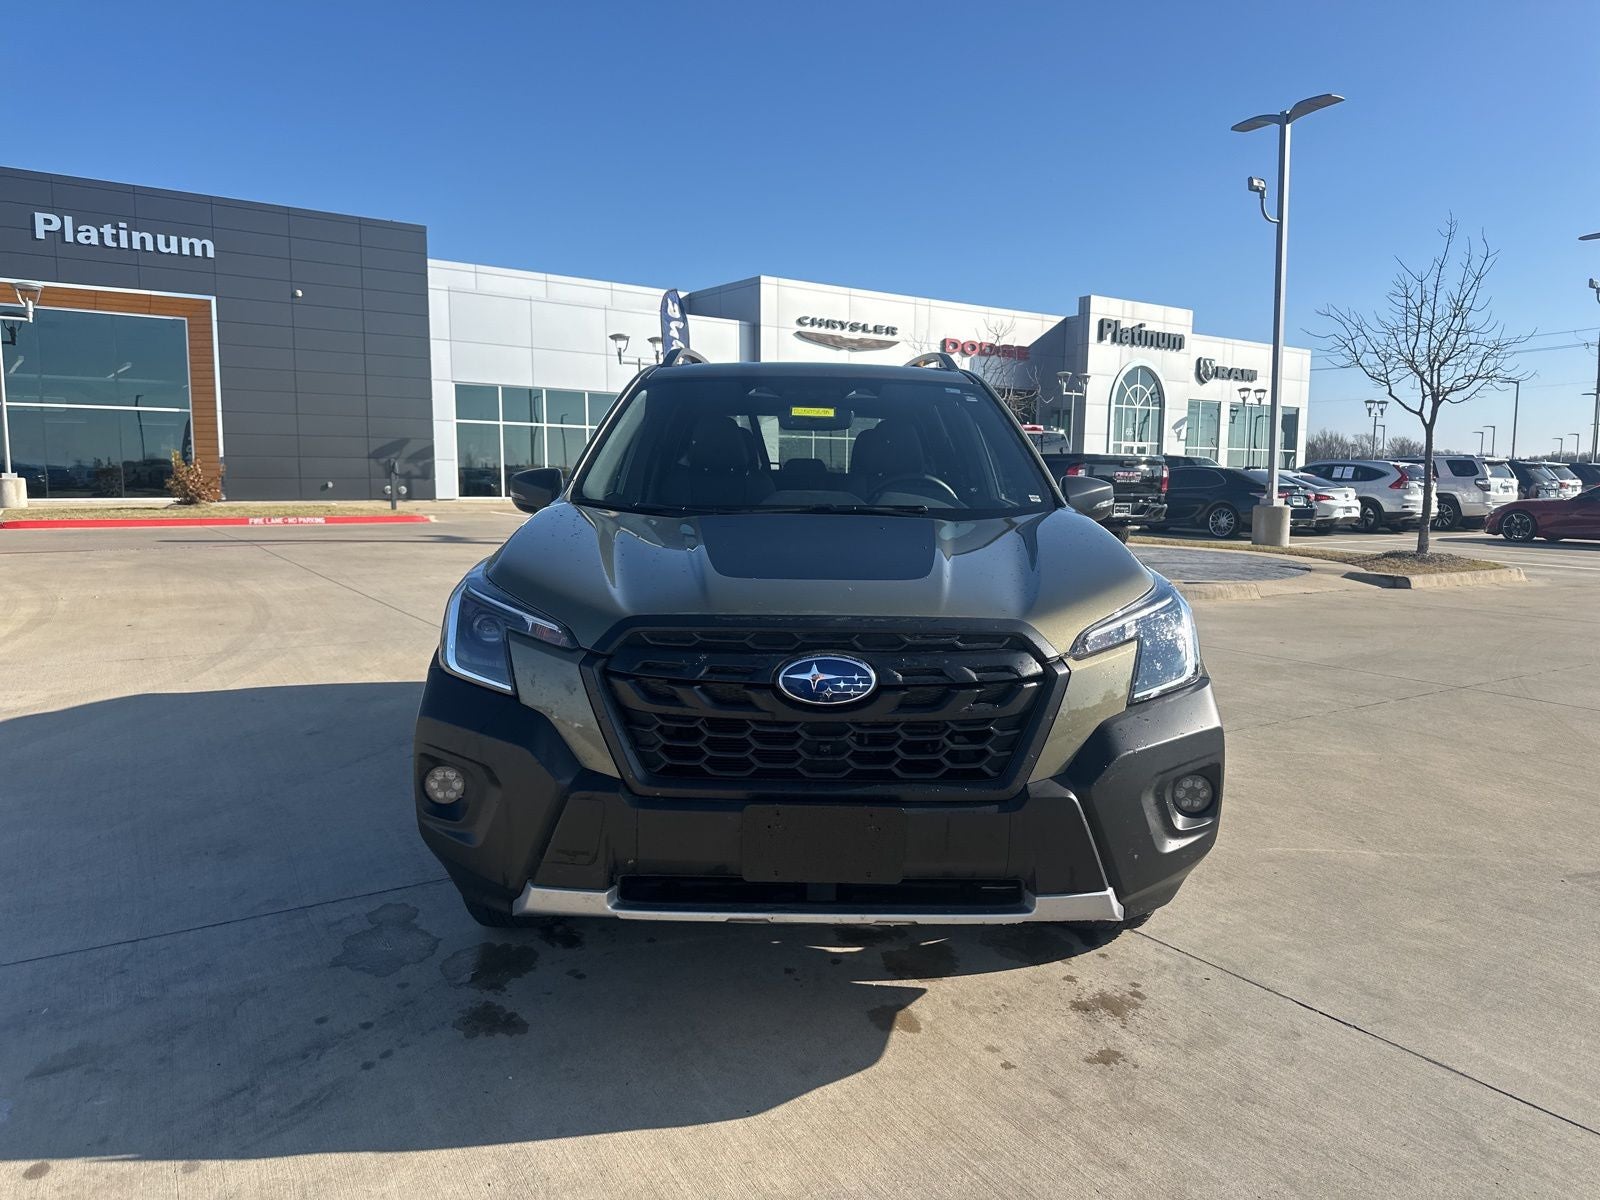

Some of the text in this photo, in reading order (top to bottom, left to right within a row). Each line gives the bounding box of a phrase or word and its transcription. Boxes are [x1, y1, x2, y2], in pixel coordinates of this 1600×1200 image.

[33, 211, 215, 259] Platinum
[795, 315, 898, 337] CHRYSLER
[1097, 317, 1185, 352] Platinum
[940, 337, 1031, 362] DODGE
[1214, 365, 1258, 383] RAM
